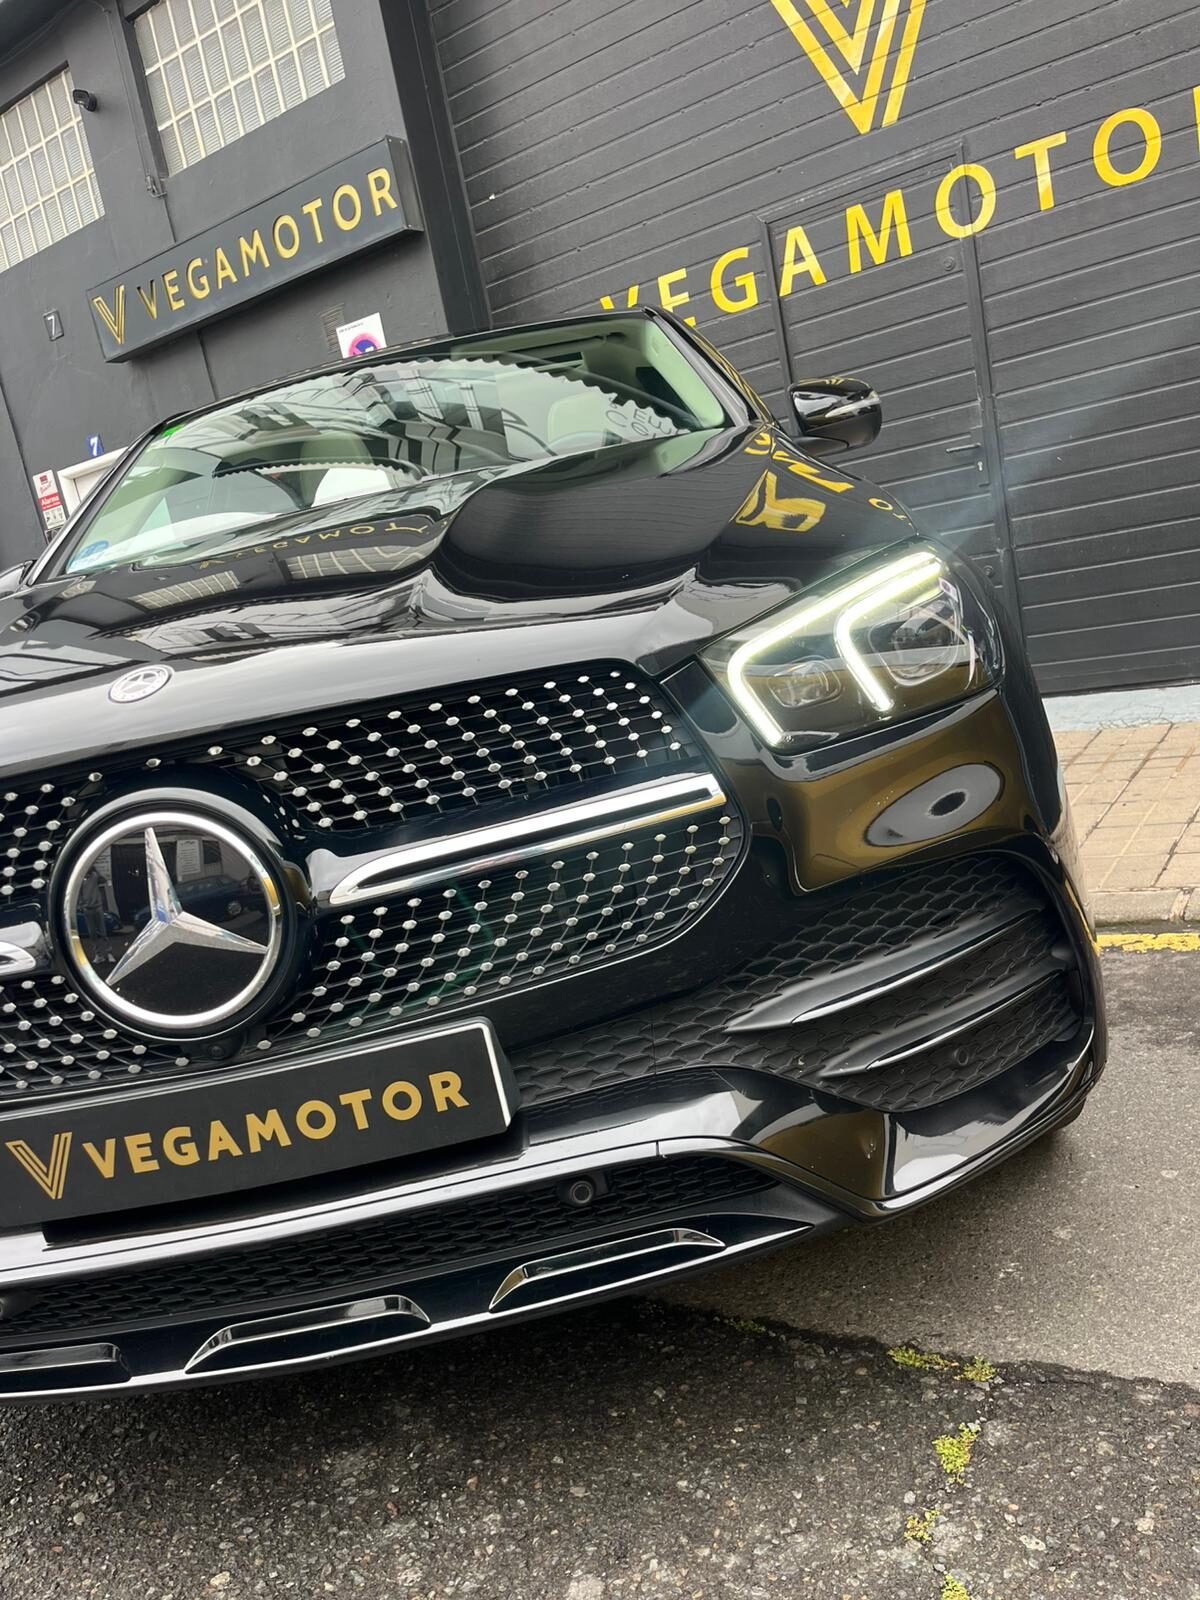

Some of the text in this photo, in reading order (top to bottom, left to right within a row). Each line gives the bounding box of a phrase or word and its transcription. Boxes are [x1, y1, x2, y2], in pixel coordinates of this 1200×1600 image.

[136, 167, 398, 320] VEGAMOTOR
[599, 85, 1200, 330] EGAMOTO
[89, 436, 99, 456] 7
[83, 1070, 470, 1179] VEGAMOTOR
